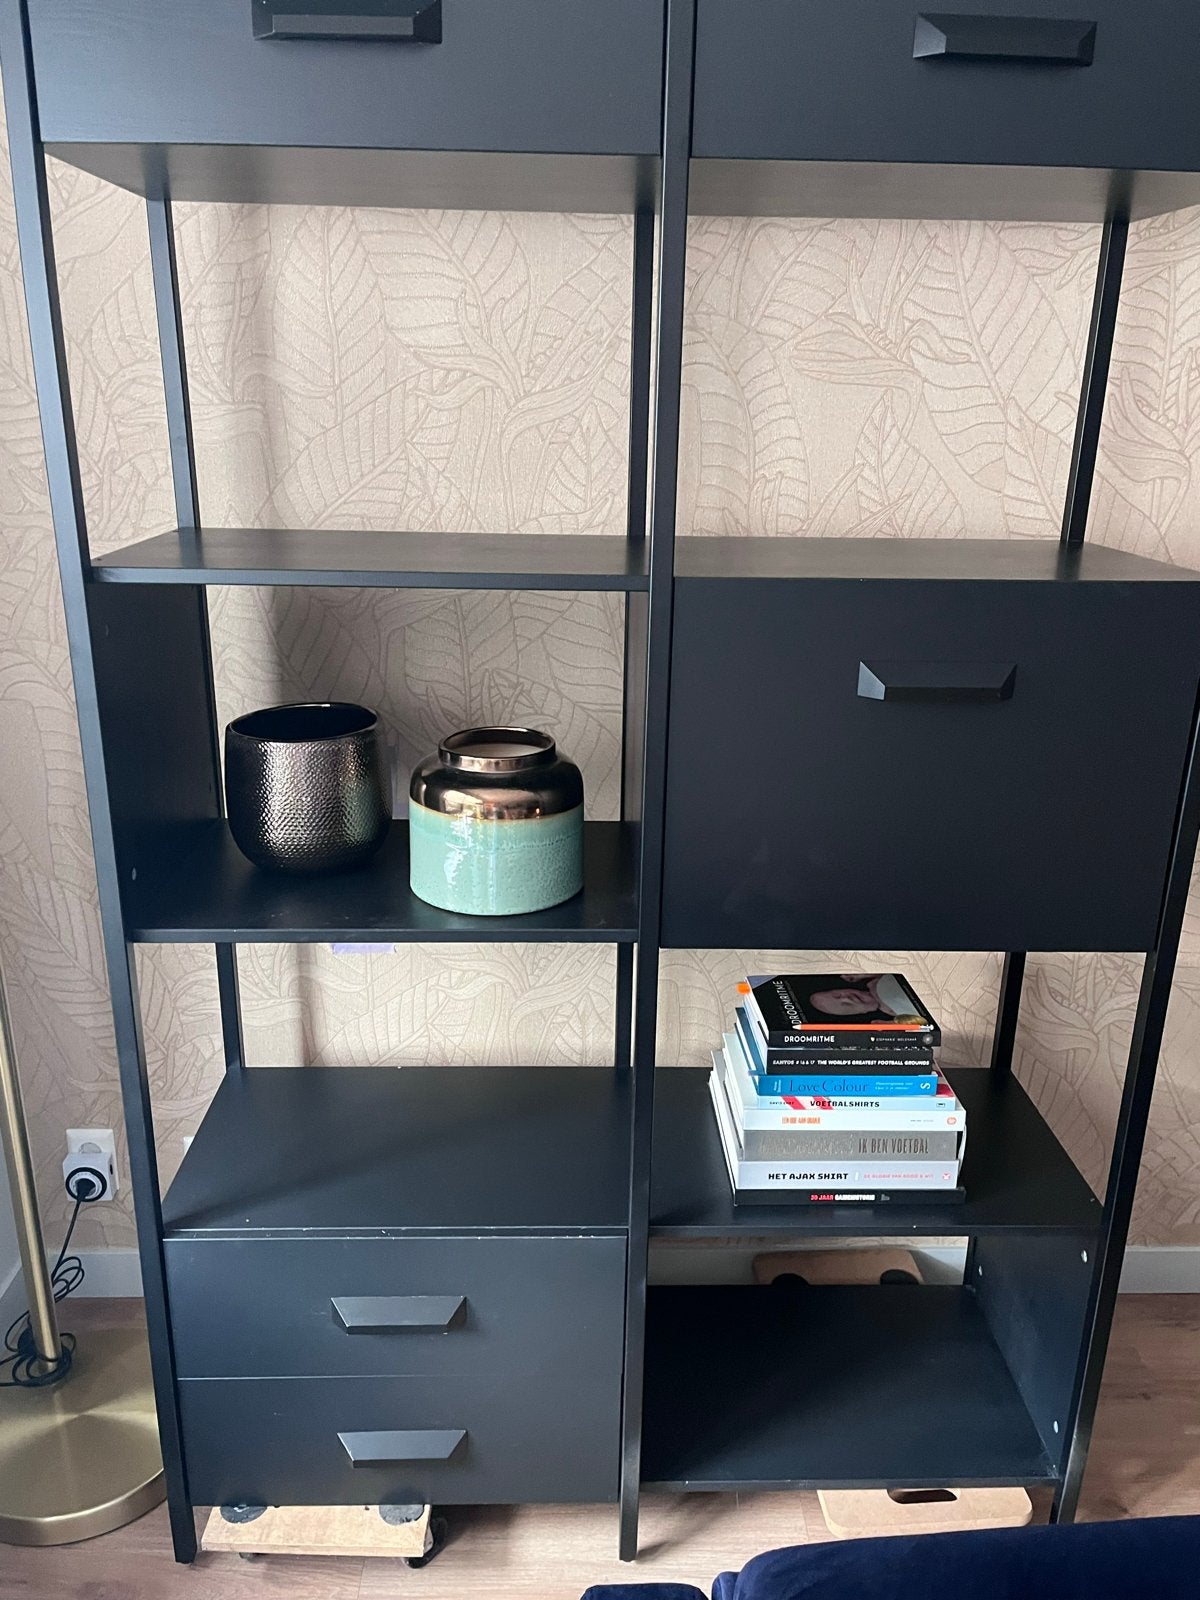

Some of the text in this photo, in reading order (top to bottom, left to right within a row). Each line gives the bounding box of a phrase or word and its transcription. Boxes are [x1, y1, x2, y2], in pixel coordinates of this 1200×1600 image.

[784, 1035, 835, 1043] DROOMRITME
[789, 1079, 821, 1093] Love
[822, 1079, 868, 1093] Colour
[810, 1100, 880, 1108] VOETBALSHIRTS
[858, 1138, 868, 1154] IK
[871, 1138, 888, 1154] BEN
[891, 1138, 929, 1154] VOETBAL
